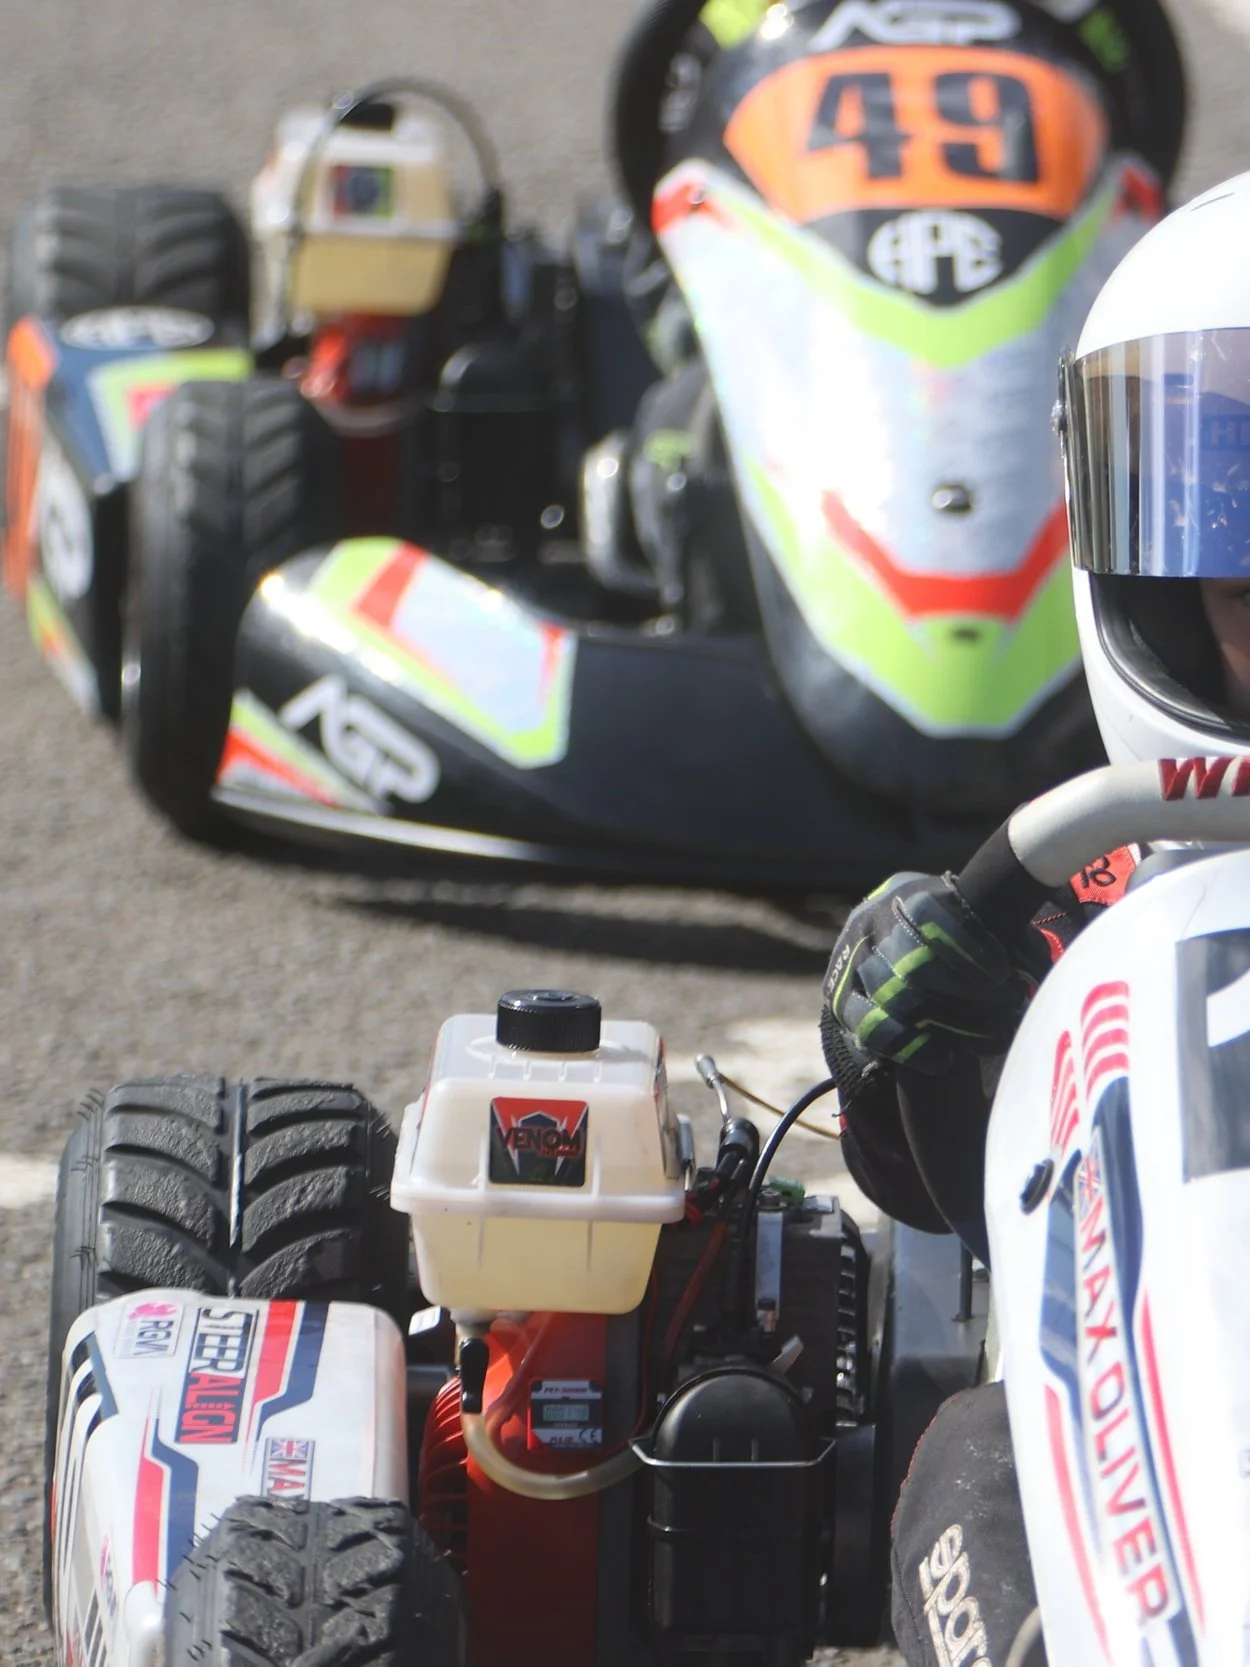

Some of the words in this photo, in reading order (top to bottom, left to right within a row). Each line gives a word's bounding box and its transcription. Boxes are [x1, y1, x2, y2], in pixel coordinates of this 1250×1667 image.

[807, 72, 1038, 183] 49
[827, 943, 850, 993] RACE
[497, 1126, 581, 1151] VENOM
[1080, 1197, 1118, 1367] MAX
[179, 1307, 255, 1445] STEERALIGN
[267, 1458, 308, 1500] MA
[1090, 1360, 1170, 1626] OLIVER
